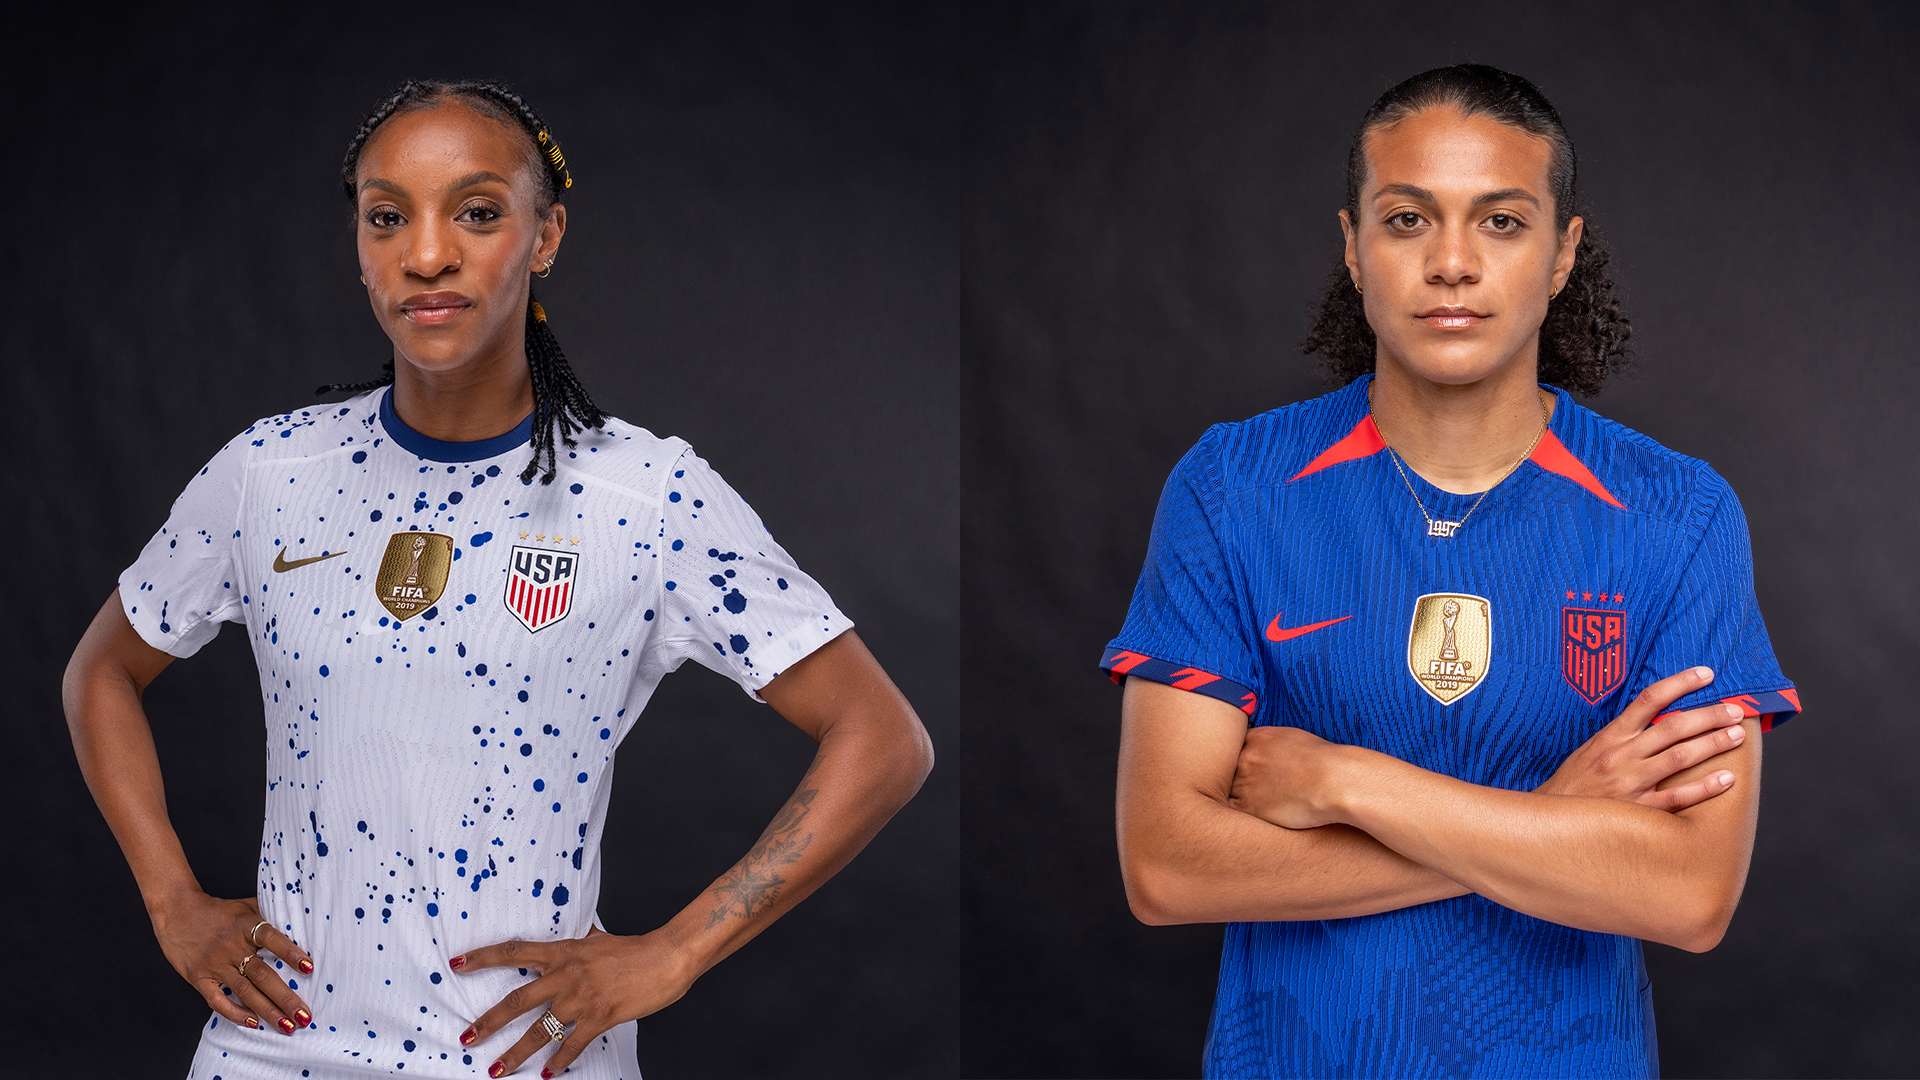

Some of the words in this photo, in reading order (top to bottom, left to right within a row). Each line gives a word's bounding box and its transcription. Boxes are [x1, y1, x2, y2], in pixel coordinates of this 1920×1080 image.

[1428, 519, 1461, 537] 1997
[515, 551, 573, 584] USA
[395, 602, 415, 610] 2019
[1567, 613, 1621, 650] USA
[1436, 680, 1458, 689] 2019
[1441, 674, 1474, 682] CHAMPIONS
